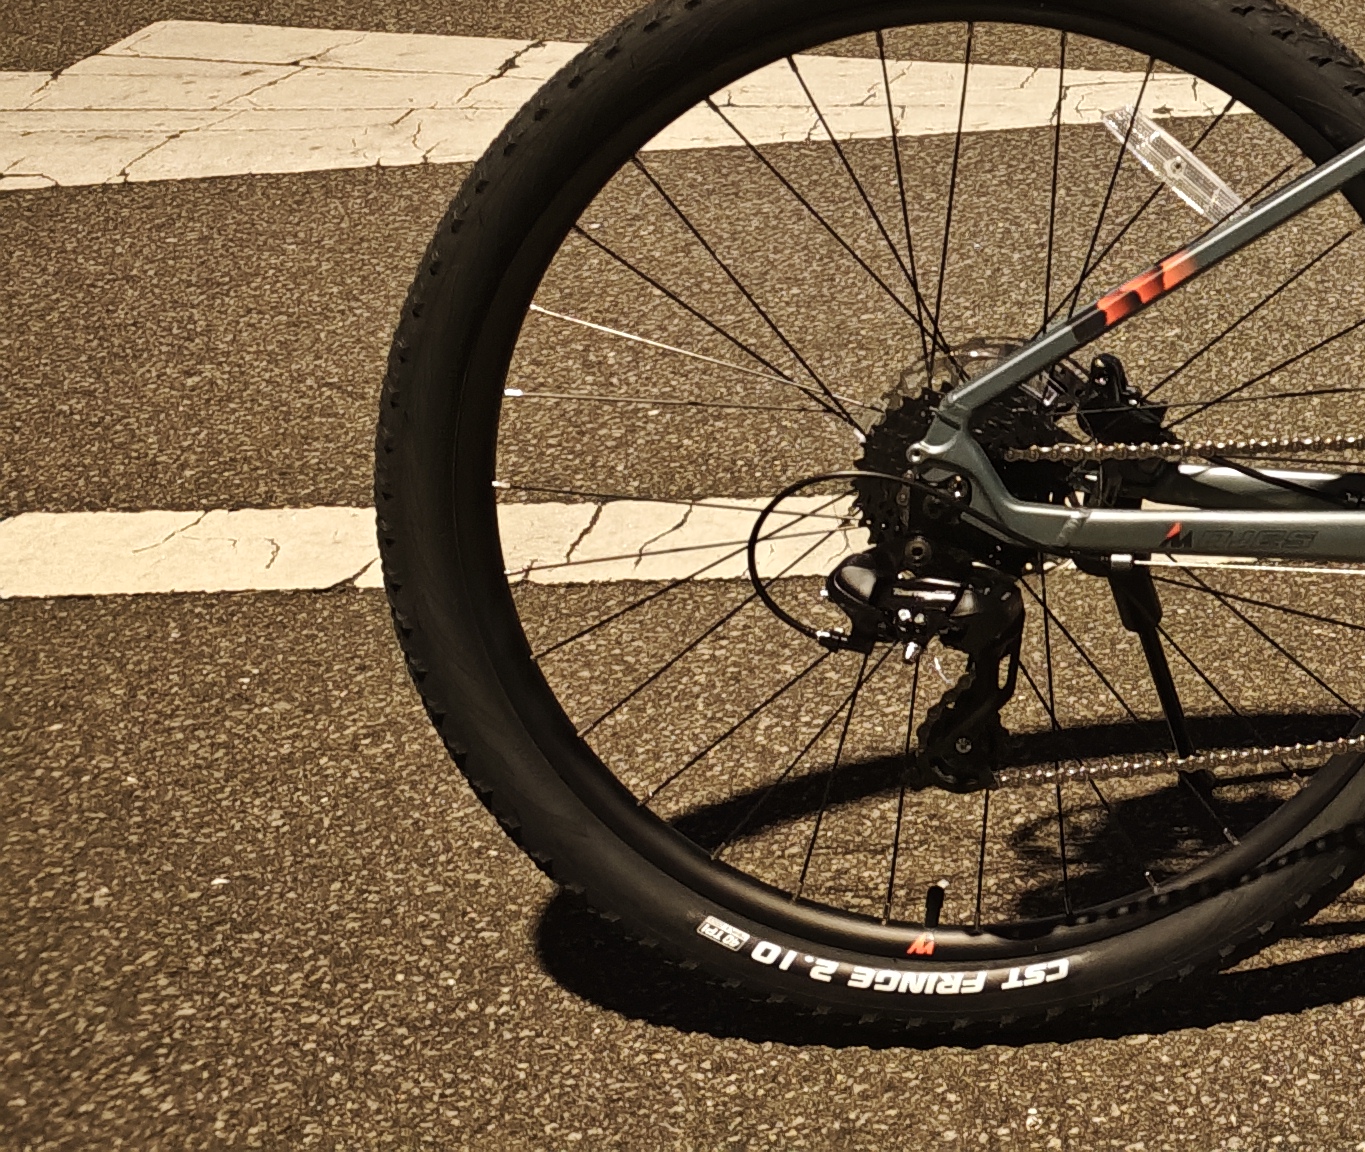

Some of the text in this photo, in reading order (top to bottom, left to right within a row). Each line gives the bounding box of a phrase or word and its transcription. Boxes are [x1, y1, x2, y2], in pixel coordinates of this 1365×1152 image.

[751, 939, 1070, 994] CST FRINGE 2.10
